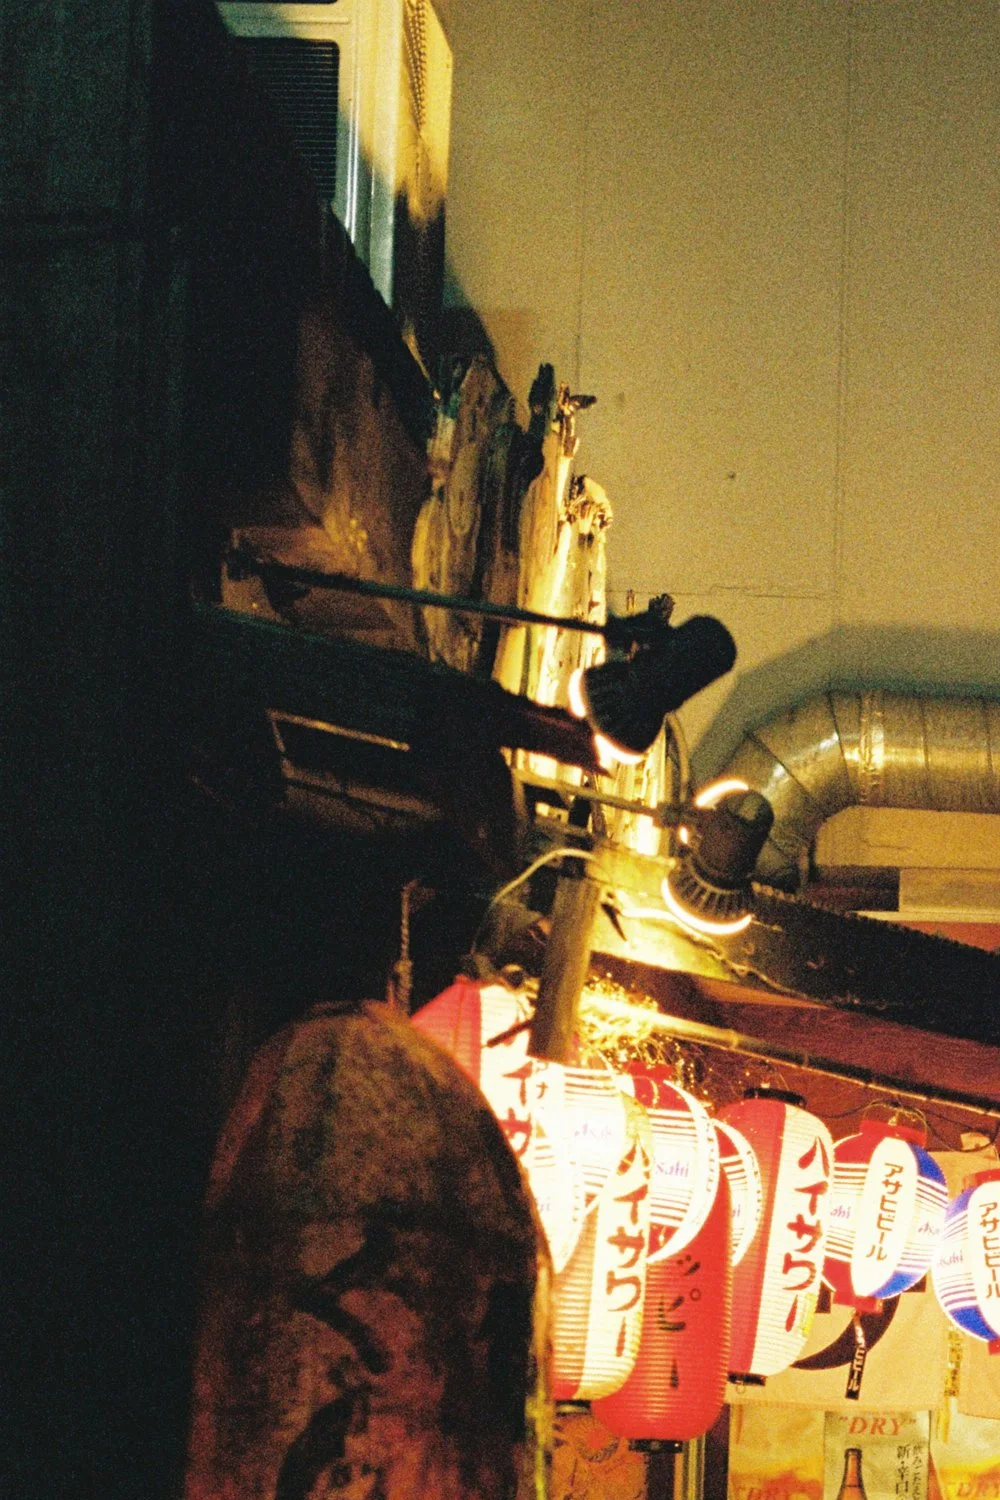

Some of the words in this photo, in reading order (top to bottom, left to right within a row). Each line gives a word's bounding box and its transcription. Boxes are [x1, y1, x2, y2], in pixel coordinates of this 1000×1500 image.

[653, 1159, 690, 1177] sahi
[781, 1135, 831, 1333] ハイサワー
[865, 1162, 904, 1262] アサヒビール
[606, 1134, 651, 1358] ハイサワー
[656, 1253, 702, 1390] ッピー
